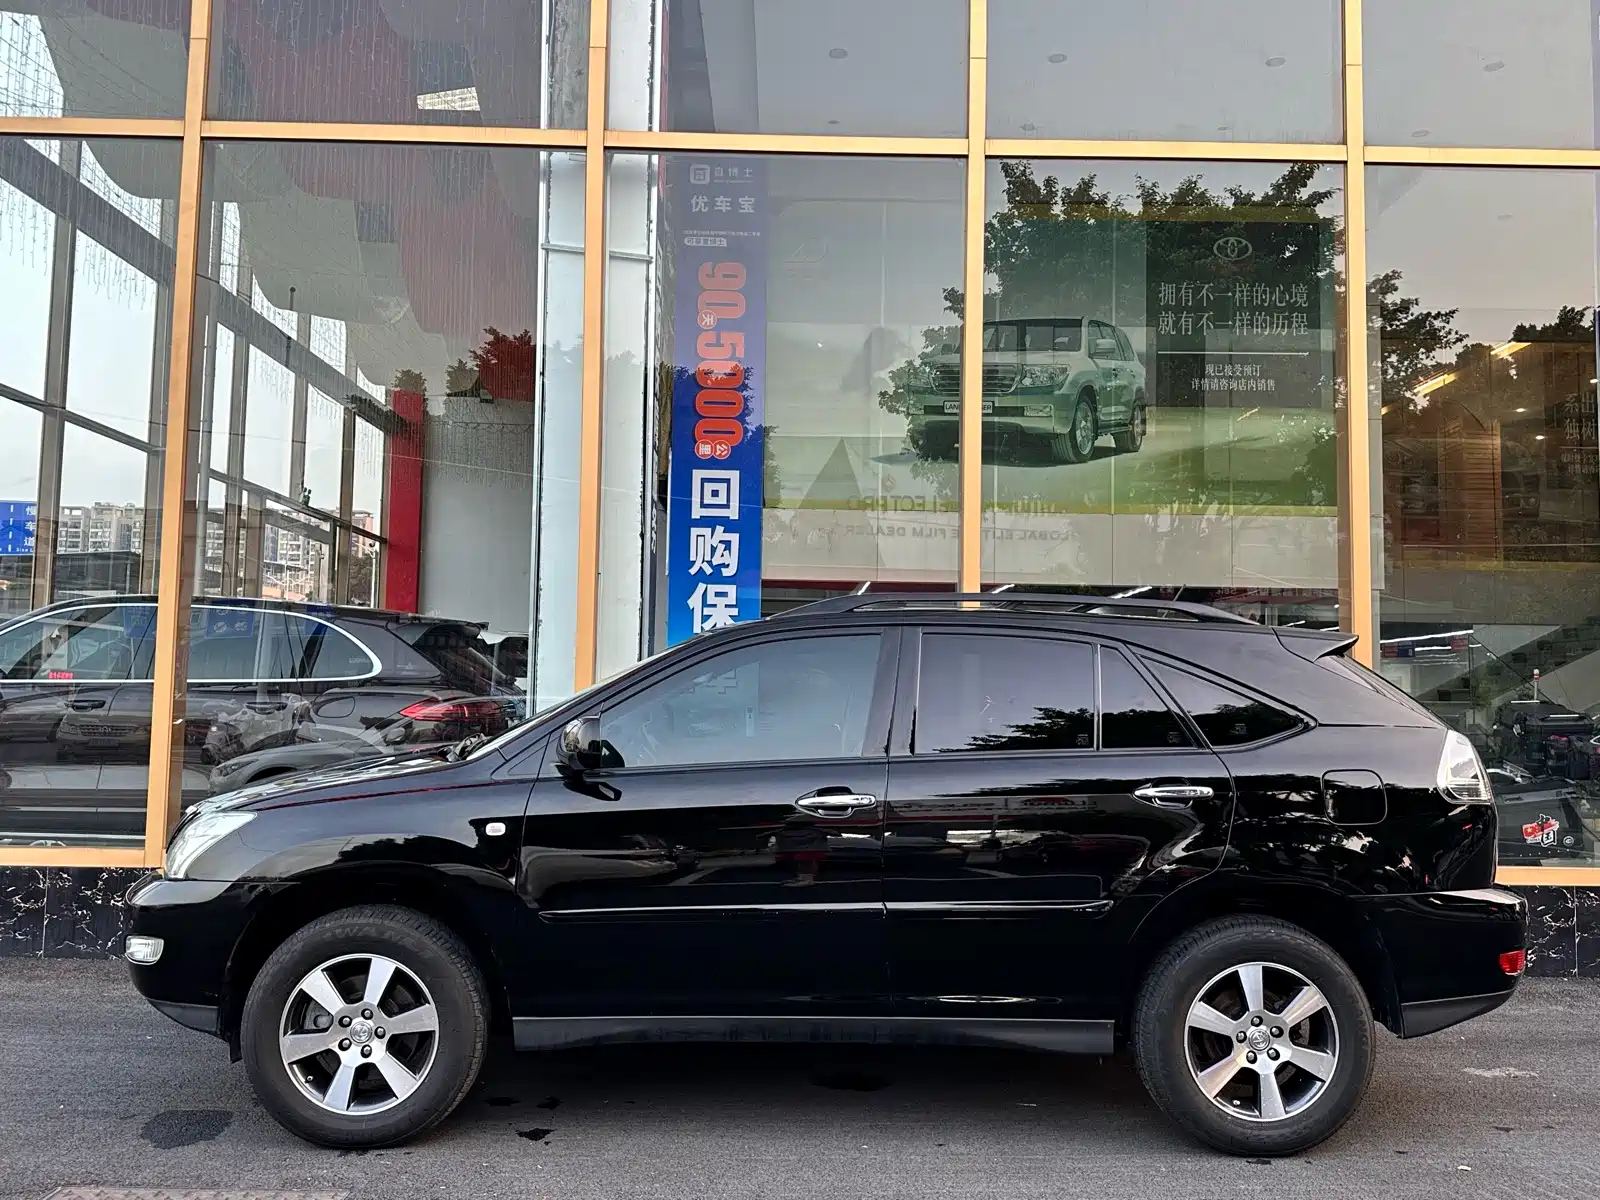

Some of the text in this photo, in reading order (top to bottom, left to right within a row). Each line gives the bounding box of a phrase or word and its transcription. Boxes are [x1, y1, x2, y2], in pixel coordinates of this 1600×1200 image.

[690, 195, 756, 213] 优车宝
[1158, 282, 1309, 307] 拥有不一样的心境
[1157, 311, 1309, 336] 就有不一样的历程
[1205, 363, 1262, 376] 现已接受预订
[1191, 378, 1276, 391] 详情请咨询店内销售
